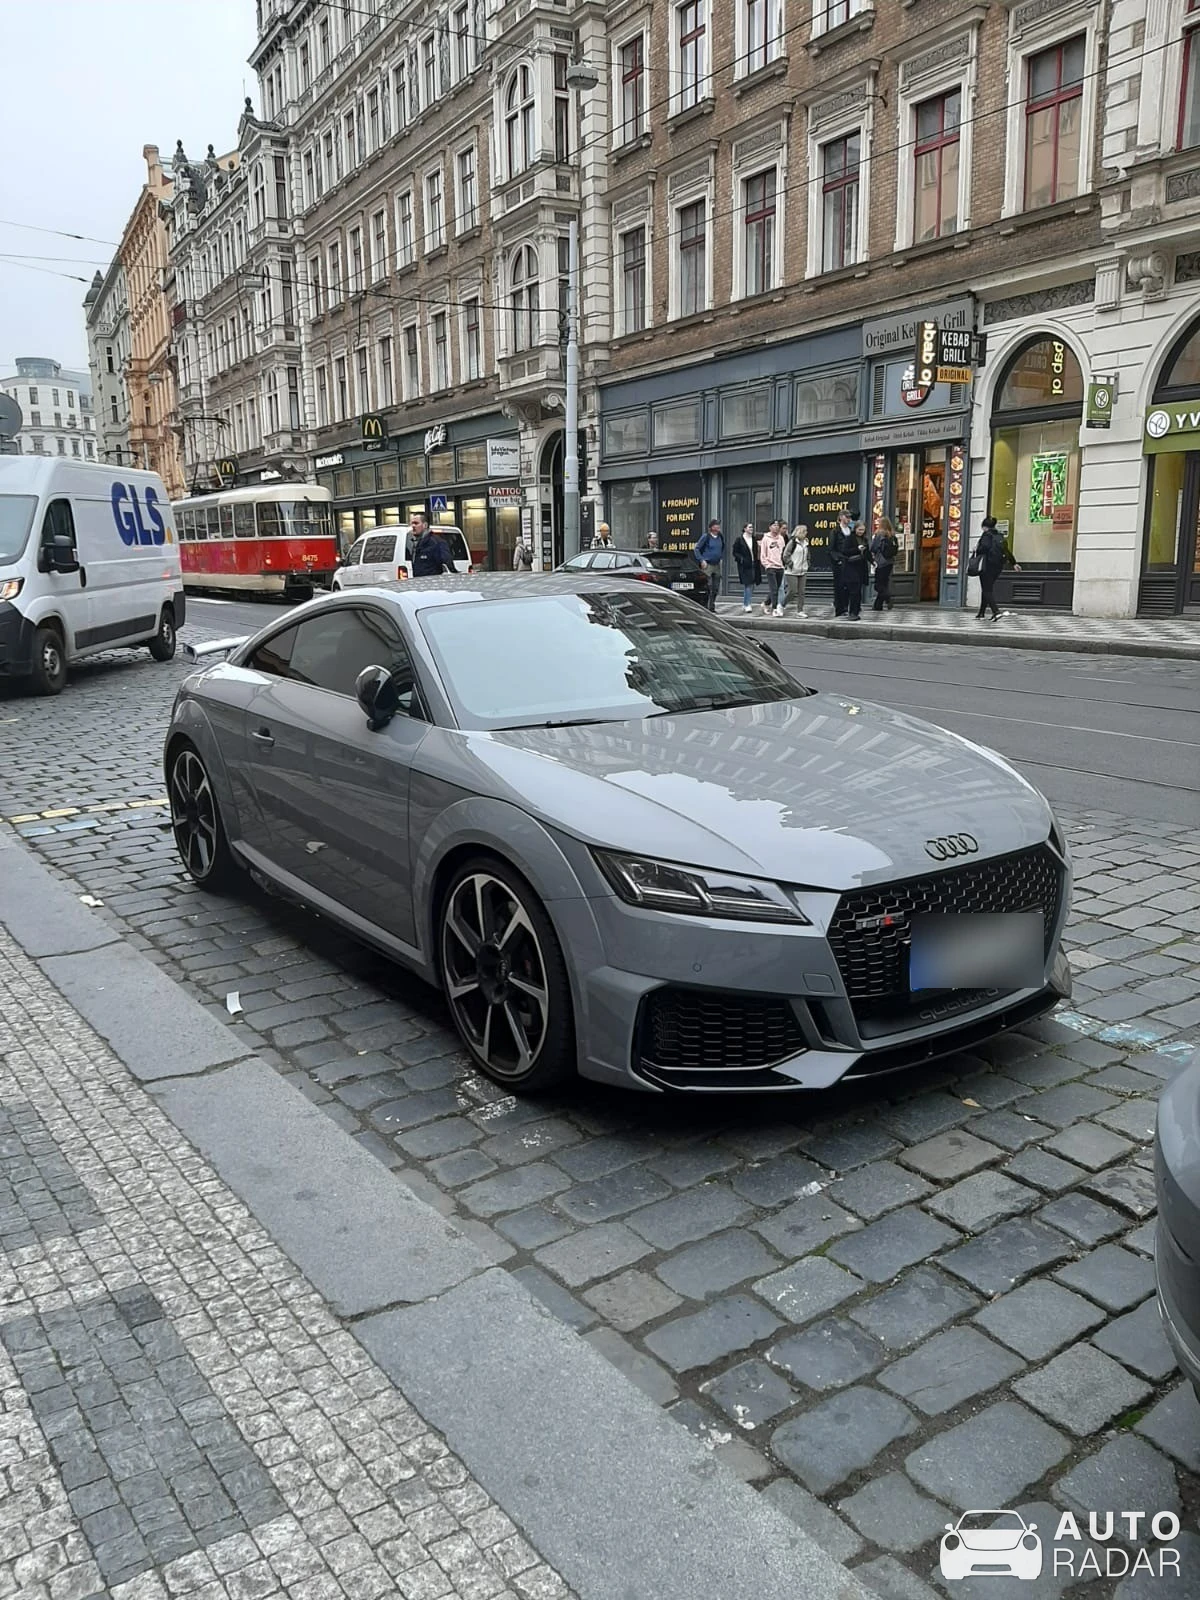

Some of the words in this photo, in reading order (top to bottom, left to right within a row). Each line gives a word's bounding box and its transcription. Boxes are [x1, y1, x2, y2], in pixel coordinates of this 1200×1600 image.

[866, 326, 899, 349] Original
[944, 310, 966, 329] Grill
[942, 331, 969, 347] KEBAB
[943, 348, 966, 363] GRILL
[939, 368, 969, 381] ORIGINAL
[906, 389, 922, 402] GRILL
[492, 487, 521, 496] TATTOO
[803, 487, 809, 496] K
[811, 482, 856, 496] PRONÁJMU
[662, 500, 667, 508] K
[667, 497, 699, 508] PRONÁJMU
[808, 503, 825, 512] FOR
[826, 501, 849, 512] RENT
[666, 514, 678, 522] FOR
[678, 513, 695, 522] RENT
[814, 520, 828, 529] 440
[810, 537, 824, 546] 606
[302, 554, 318, 562] 8475
